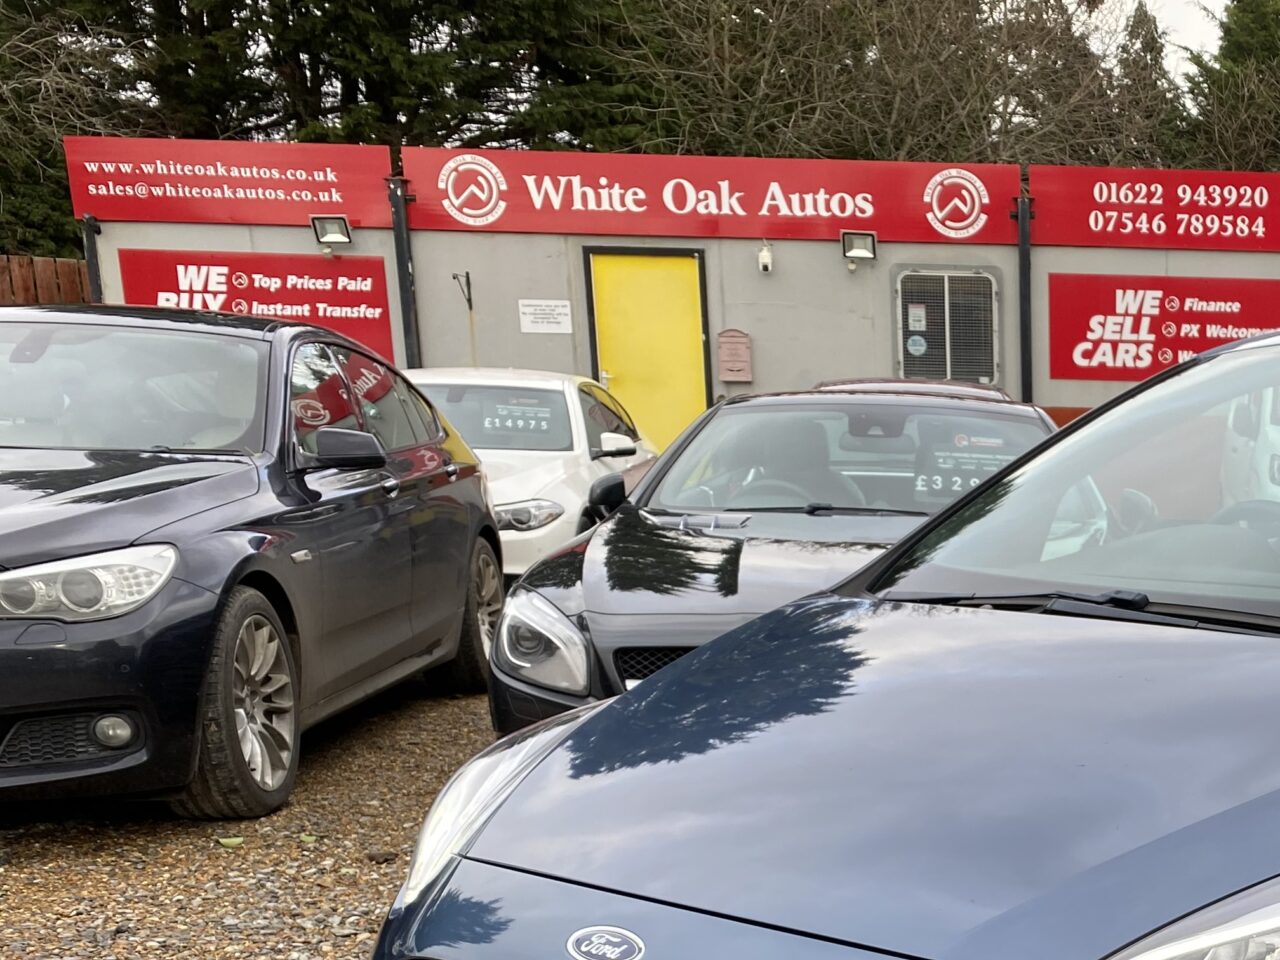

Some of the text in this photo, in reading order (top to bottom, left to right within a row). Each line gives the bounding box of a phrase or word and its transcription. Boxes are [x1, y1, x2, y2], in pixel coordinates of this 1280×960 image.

[84, 160, 338, 182] www.whiteoakautos.co.uk
[88, 181, 343, 203] sales@whiteoakautos.co.uk
[522, 174, 874, 218] White Oak Autos
[1093, 181, 1269, 208] 01622 943920
[1088, 210, 1266, 237] 07546 789584
[176, 264, 229, 291] WE
[251, 274, 373, 292] Top Prices Paid
[251, 301, 383, 319] Instant Transfer
[1115, 289, 1164, 315] WE
[1183, 297, 1242, 313] Finance
[1086, 315, 1156, 342] SELL
[1179, 323, 1201, 338] PX
[1072, 342, 1153, 368] CARS
[580, 933, 628, 959] Ford
